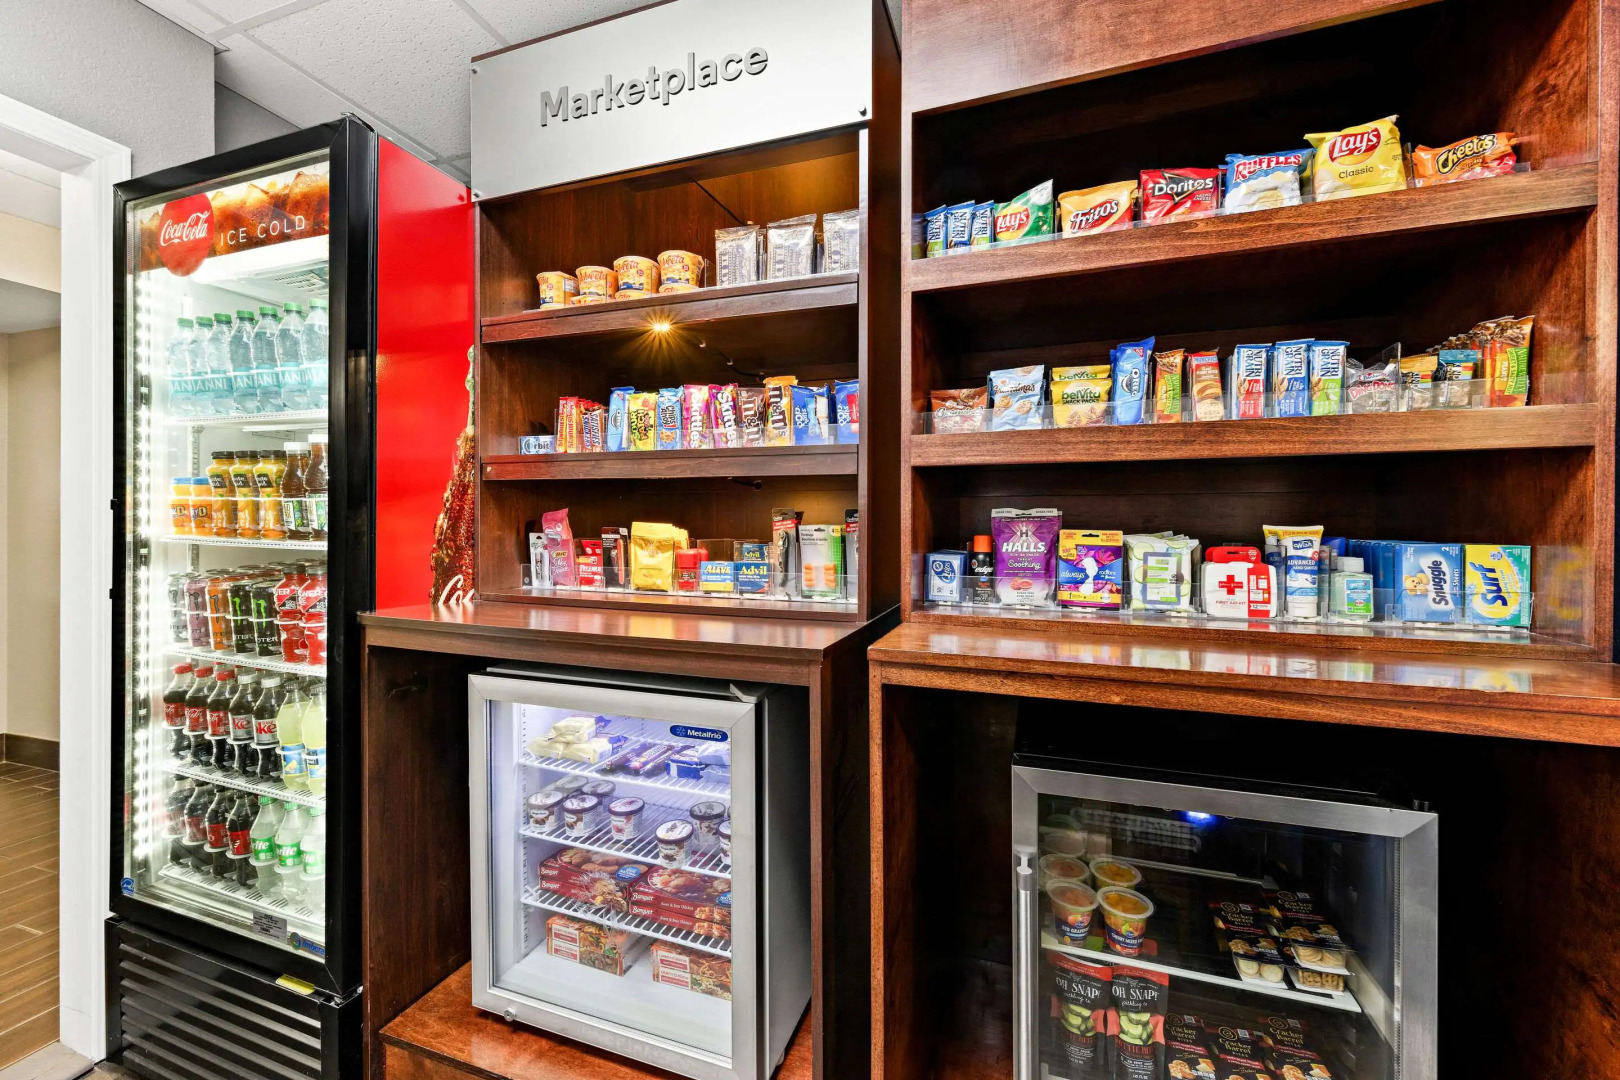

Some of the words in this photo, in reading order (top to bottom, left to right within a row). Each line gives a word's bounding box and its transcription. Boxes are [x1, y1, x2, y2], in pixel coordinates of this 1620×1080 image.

[541, 47, 768, 127] Marketplace
[1332, 130, 1379, 158] Lay's
[1436, 133, 1498, 175] Cheetos
[1233, 154, 1302, 182] RUFFLES
[1338, 166, 1374, 179] Classic
[1154, 178, 1214, 196] Doritos
[160, 210, 210, 247] Coca-Cola
[1070, 199, 1119, 235] Fritos
[220, 227, 247, 247] ICE
[258, 215, 305, 239] COLD
[1253, 350, 1263, 377] NUTRI
[1284, 347, 1294, 376] GRAIN
[1294, 347, 1303, 374] NUTRI
[1320, 348, 1330, 377] GRAIN
[1330, 348, 1339, 376] NUTRI
[1062, 388, 1101, 400] belVita
[1131, 368, 1140, 397] OREO
[689, 388, 702, 448] Skittles
[716, 390, 738, 448] Skittles
[768, 385, 788, 437] m&m's
[582, 414, 592, 449] SNICKERS
[589, 412, 600, 446] SATISFIES
[1002, 542, 1046, 554] HALLS
[740, 566, 767, 575] Advil
[974, 565, 993, 574] edge
[1008, 560, 1042, 570] Soothing
[1060, 569, 1086, 581] always
[1427, 559, 1450, 606] Snuggle
[1469, 561, 1508, 607] Surf
[687, 730, 722, 740] Metalfrio
[541, 880, 560, 890] Banquet
[632, 892, 654, 901] Banquet
[632, 905, 653, 915] Banquet
[1056, 977, 1068, 991] OH
[1112, 985, 1126, 999] OH
[1130, 989, 1159, 1002] SNAP!
[1166, 1023, 1197, 1036] Cracker
[1171, 1030, 1196, 1041] Barrel
[1219, 1037, 1252, 1050] Cracker
[1225, 1043, 1252, 1055] Barrel
